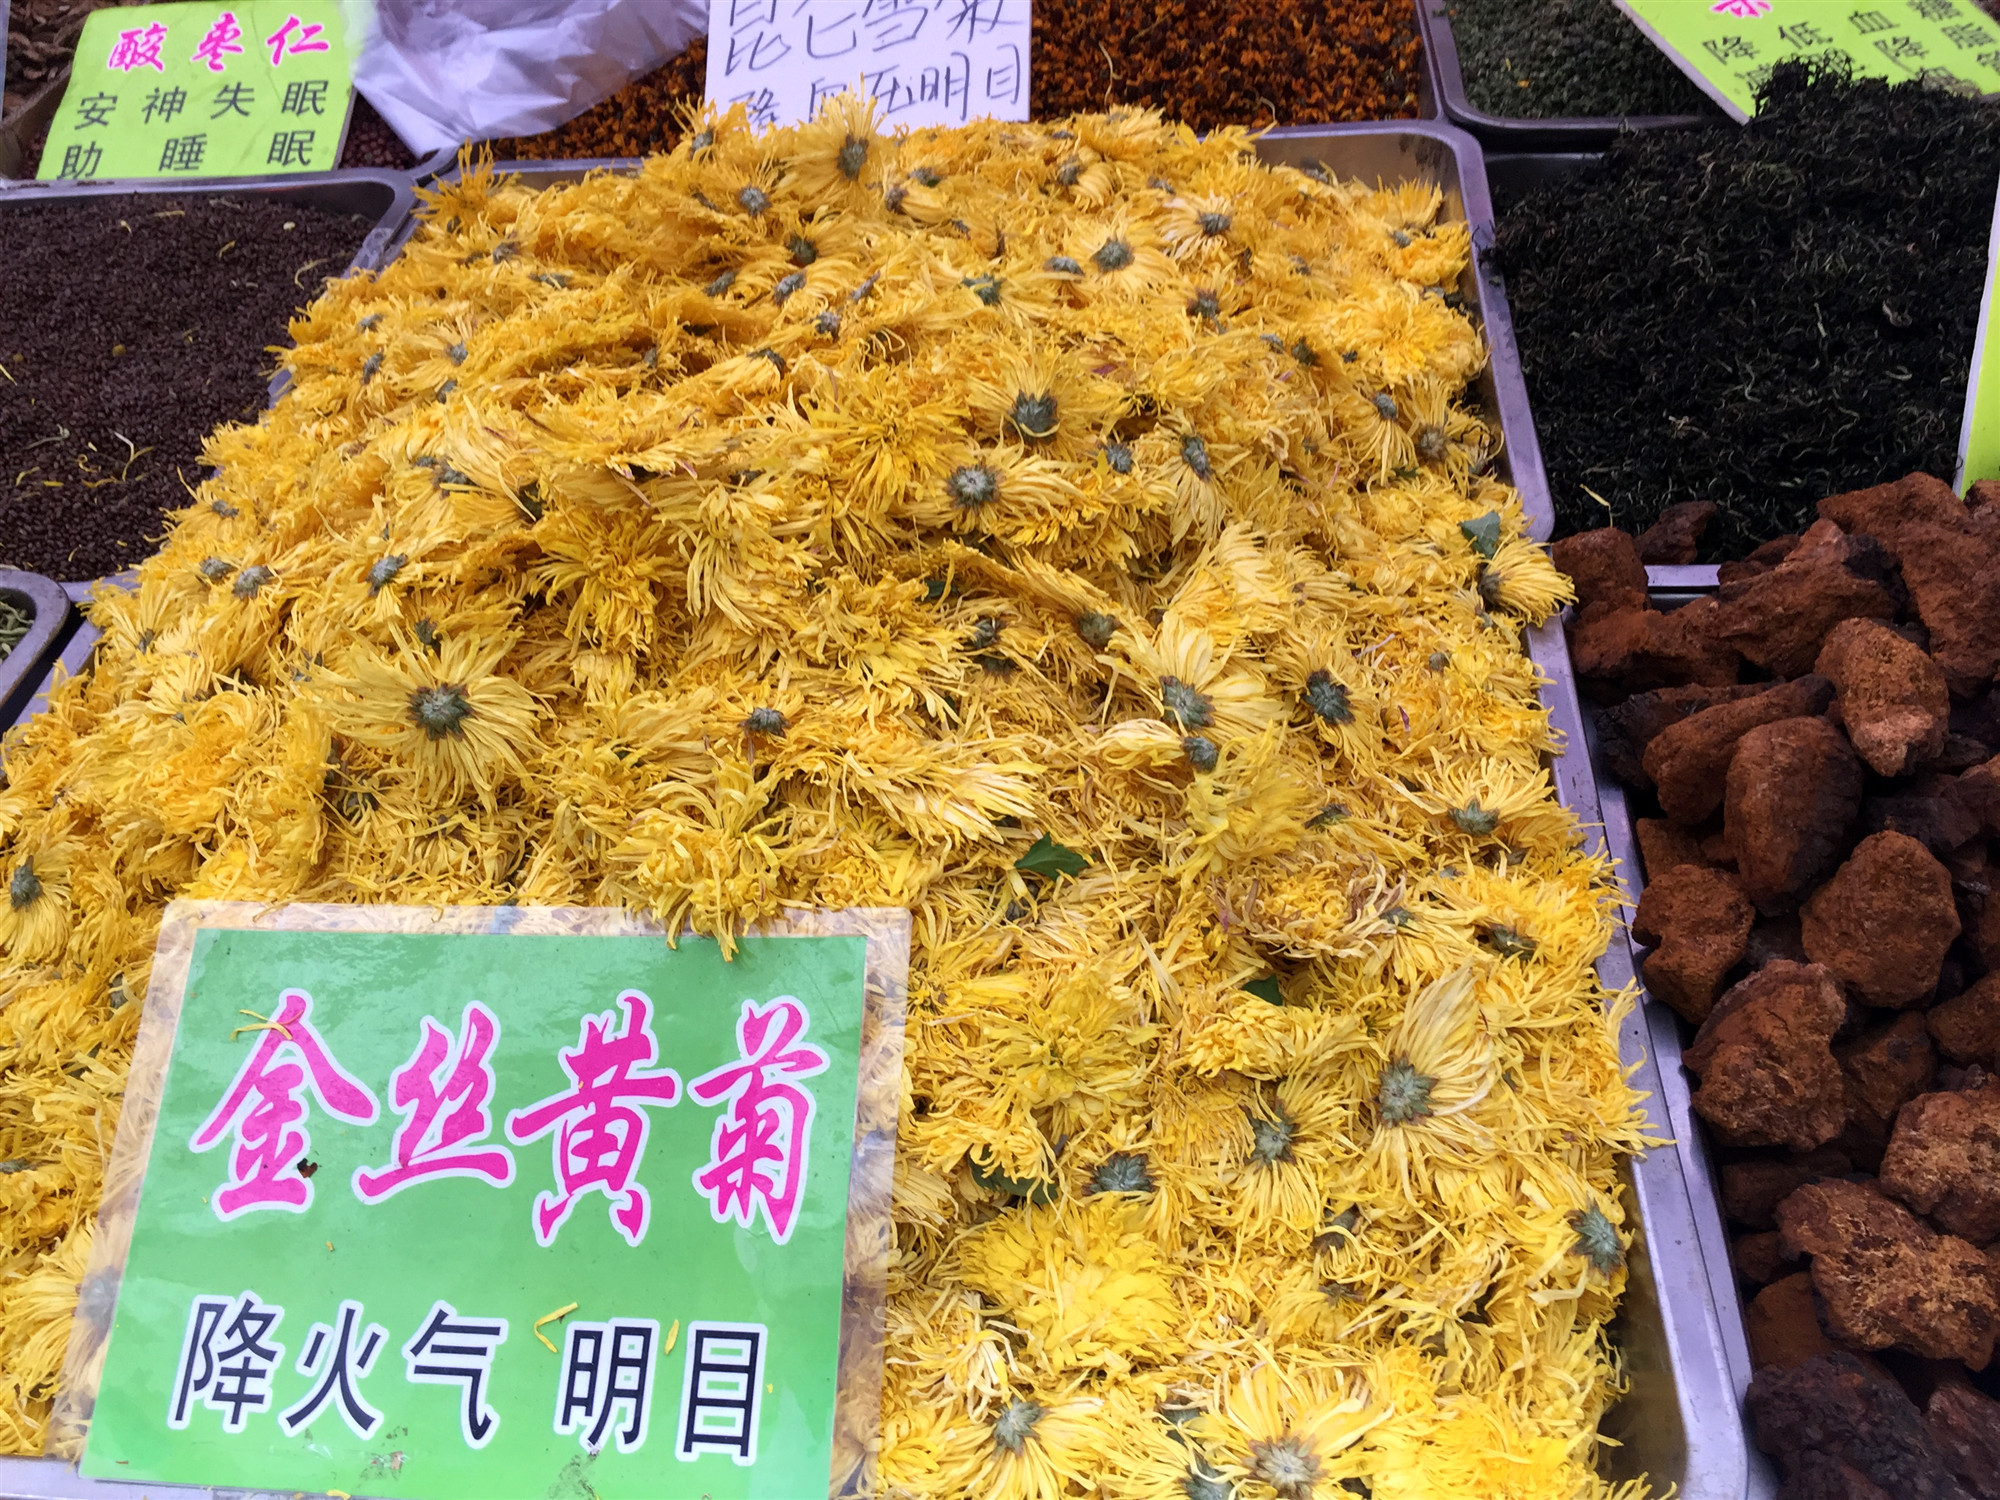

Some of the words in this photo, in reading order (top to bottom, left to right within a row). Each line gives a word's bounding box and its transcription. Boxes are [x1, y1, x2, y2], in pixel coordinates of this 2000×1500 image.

[107, 11, 331, 73] 酸枣仁
[74, 79, 330, 130] 安神失眠
[57, 130, 316, 180] 助睡眠
[191, 988, 827, 1245] 金丝黄菊
